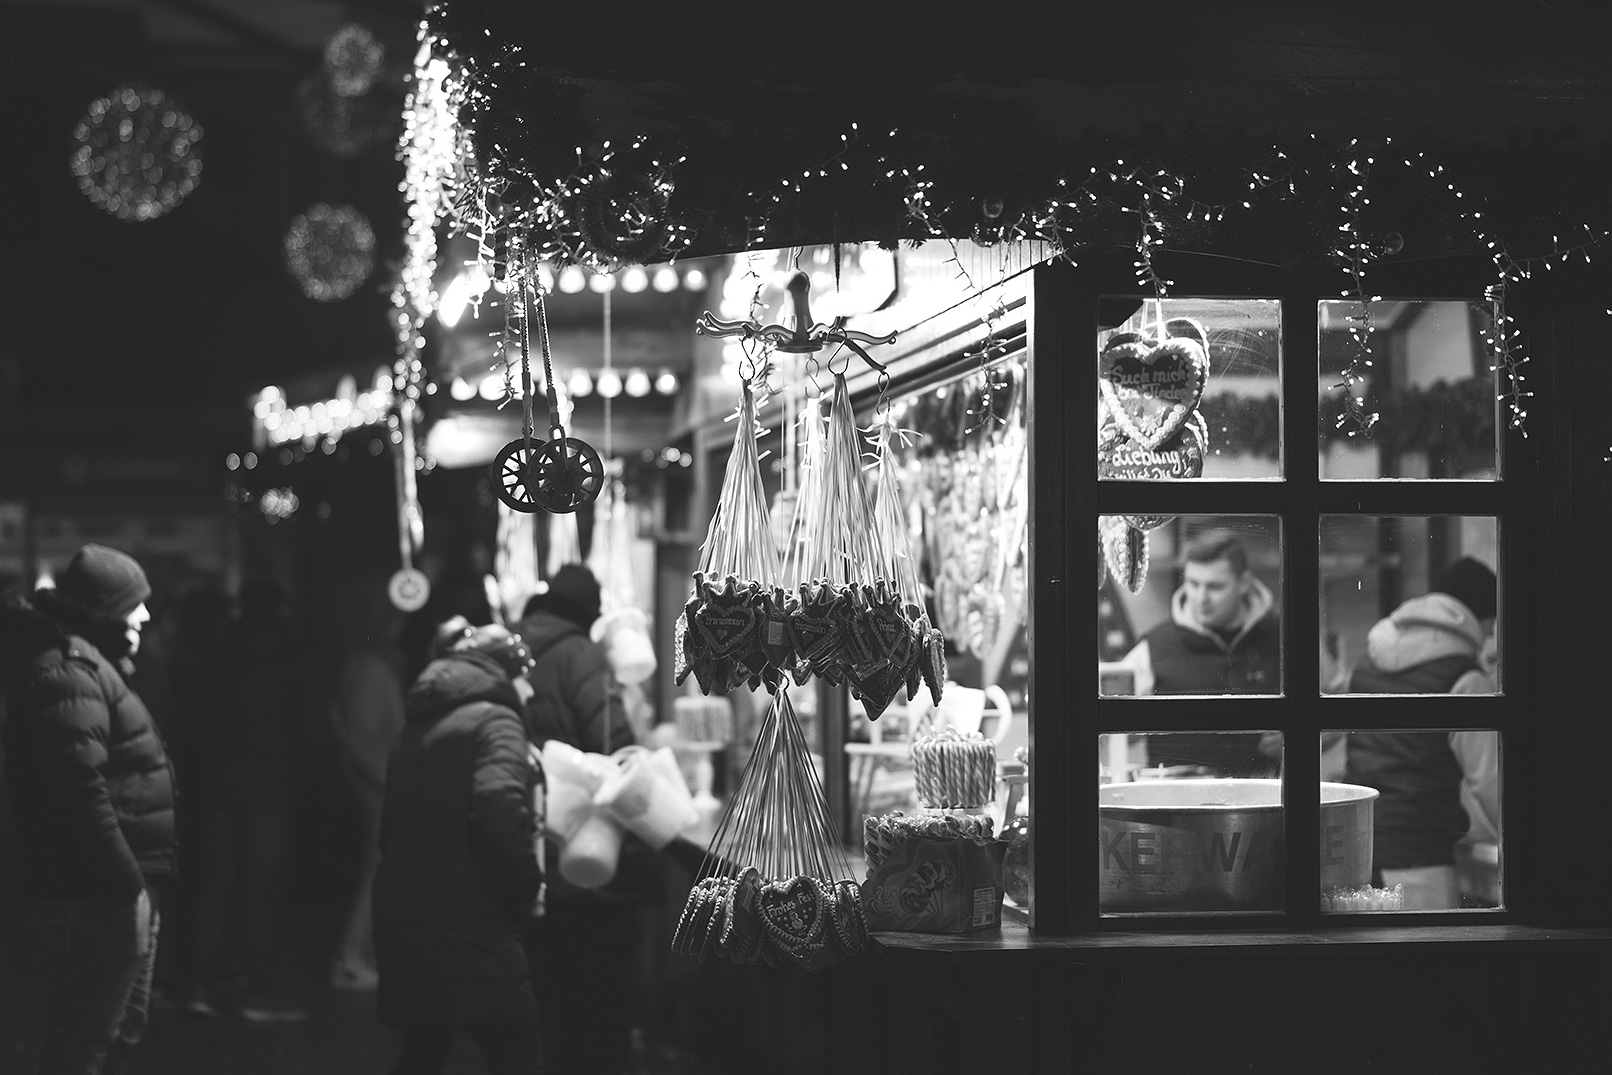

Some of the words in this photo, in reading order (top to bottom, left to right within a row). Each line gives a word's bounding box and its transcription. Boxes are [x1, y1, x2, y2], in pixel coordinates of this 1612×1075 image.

[1111, 366, 1149, 384] Such
[1152, 360, 1186, 382] mich
[705, 614, 745, 627] Prinzessin
[877, 617, 896, 632] Prinz
[766, 900, 796, 919] Frohes
[797, 890, 815, 905] Fest
